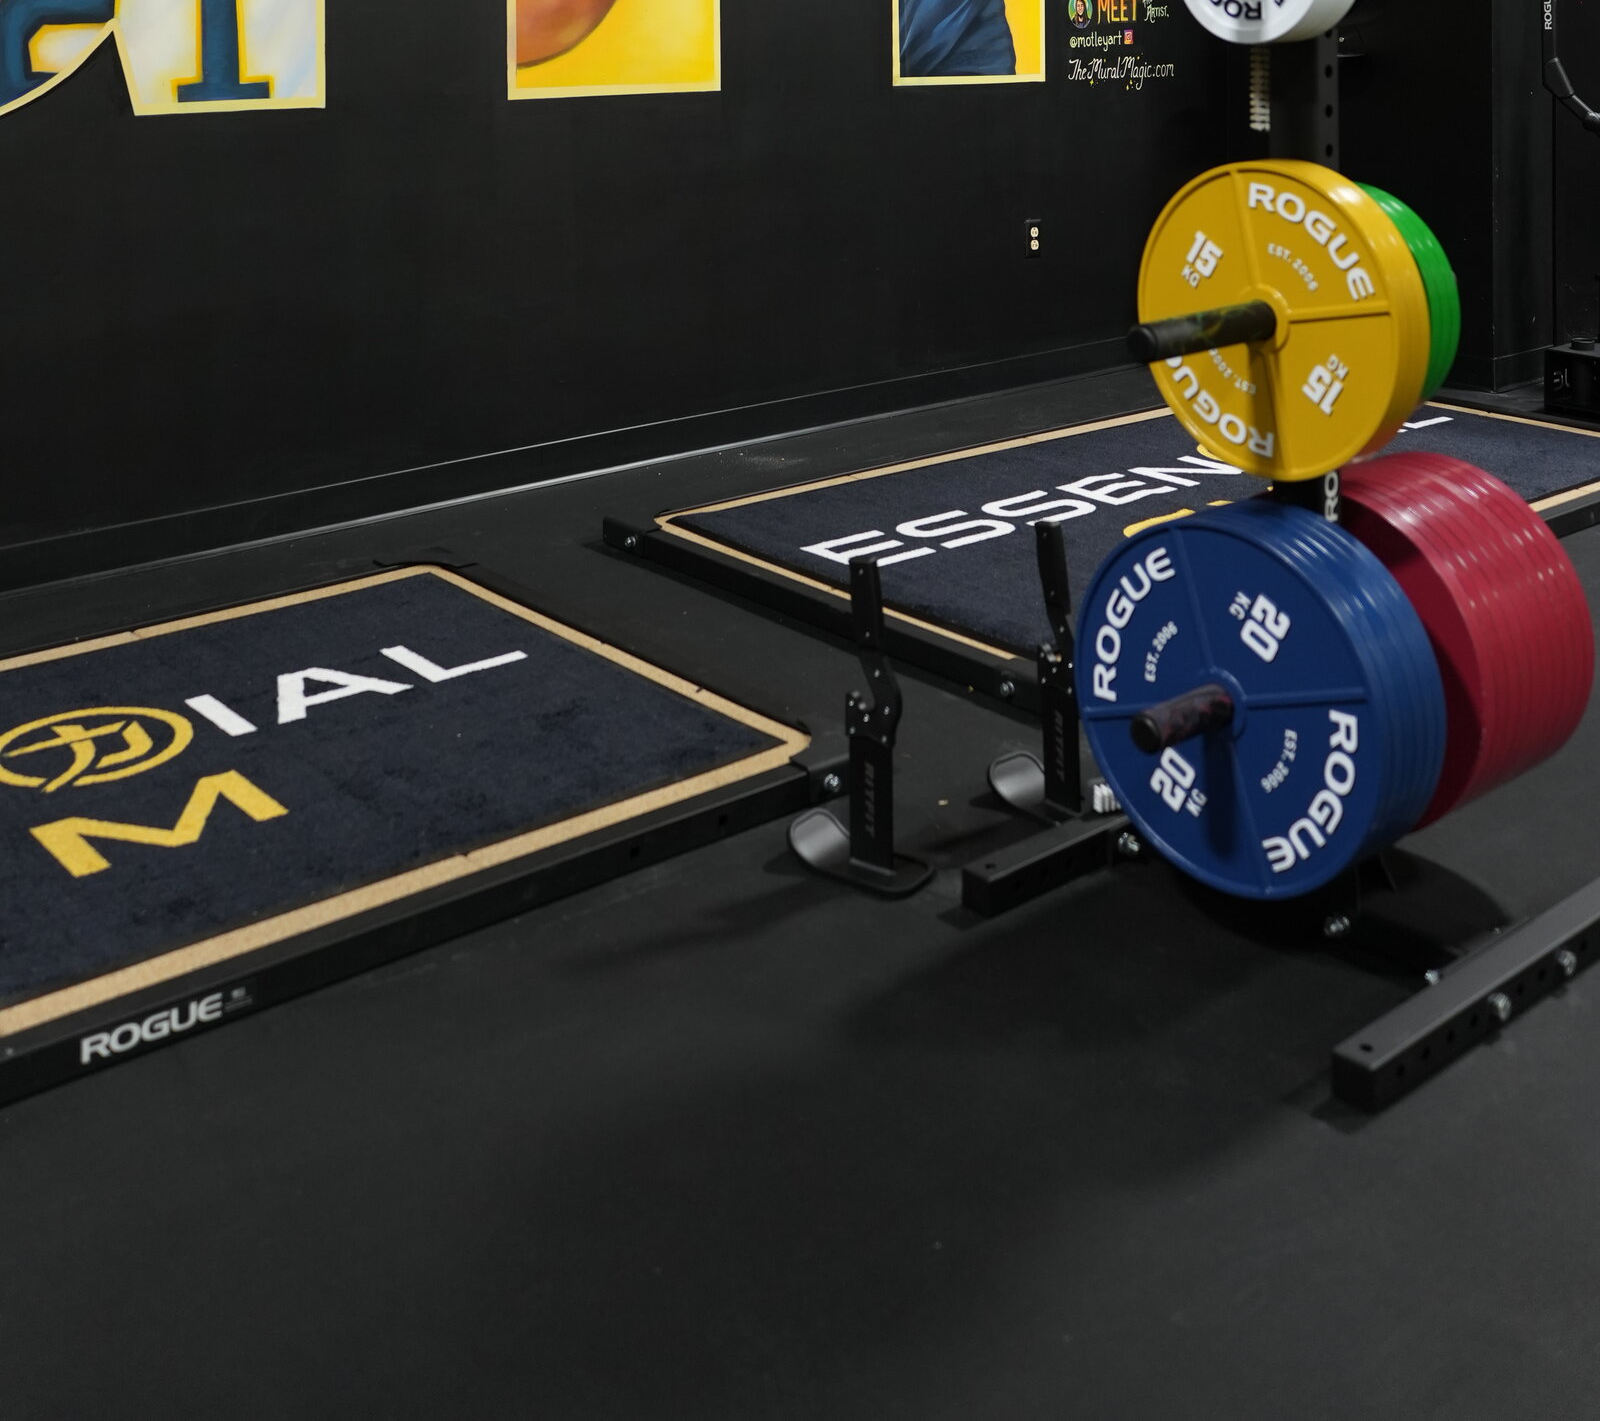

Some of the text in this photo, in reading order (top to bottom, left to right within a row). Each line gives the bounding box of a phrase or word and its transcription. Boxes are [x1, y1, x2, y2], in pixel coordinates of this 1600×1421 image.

[1069, 30, 1122, 52] @motleyart
[1186, 231, 1224, 278] 15
[1248, 181, 1375, 301] ROGUE
[1181, 264, 1200, 289] KG
[1292, 259, 1319, 292] 2006
[1302, 364, 1344, 415] 15
[1326, 354, 1348, 379] KG
[1093, 546, 1176, 702] ROGUE
[1228, 591, 1252, 620] KG
[1240, 593, 1291, 663] 20
[1152, 620, 1178, 651] 2006
[1150, 746, 1195, 812] 20
[1261, 761, 1290, 793] 2006
[1262, 709, 1358, 872] ROGUE
[29, 770, 289, 878] M
[1185, 788, 1208, 817] KG
[79, 992, 223, 1065] ROGUE
